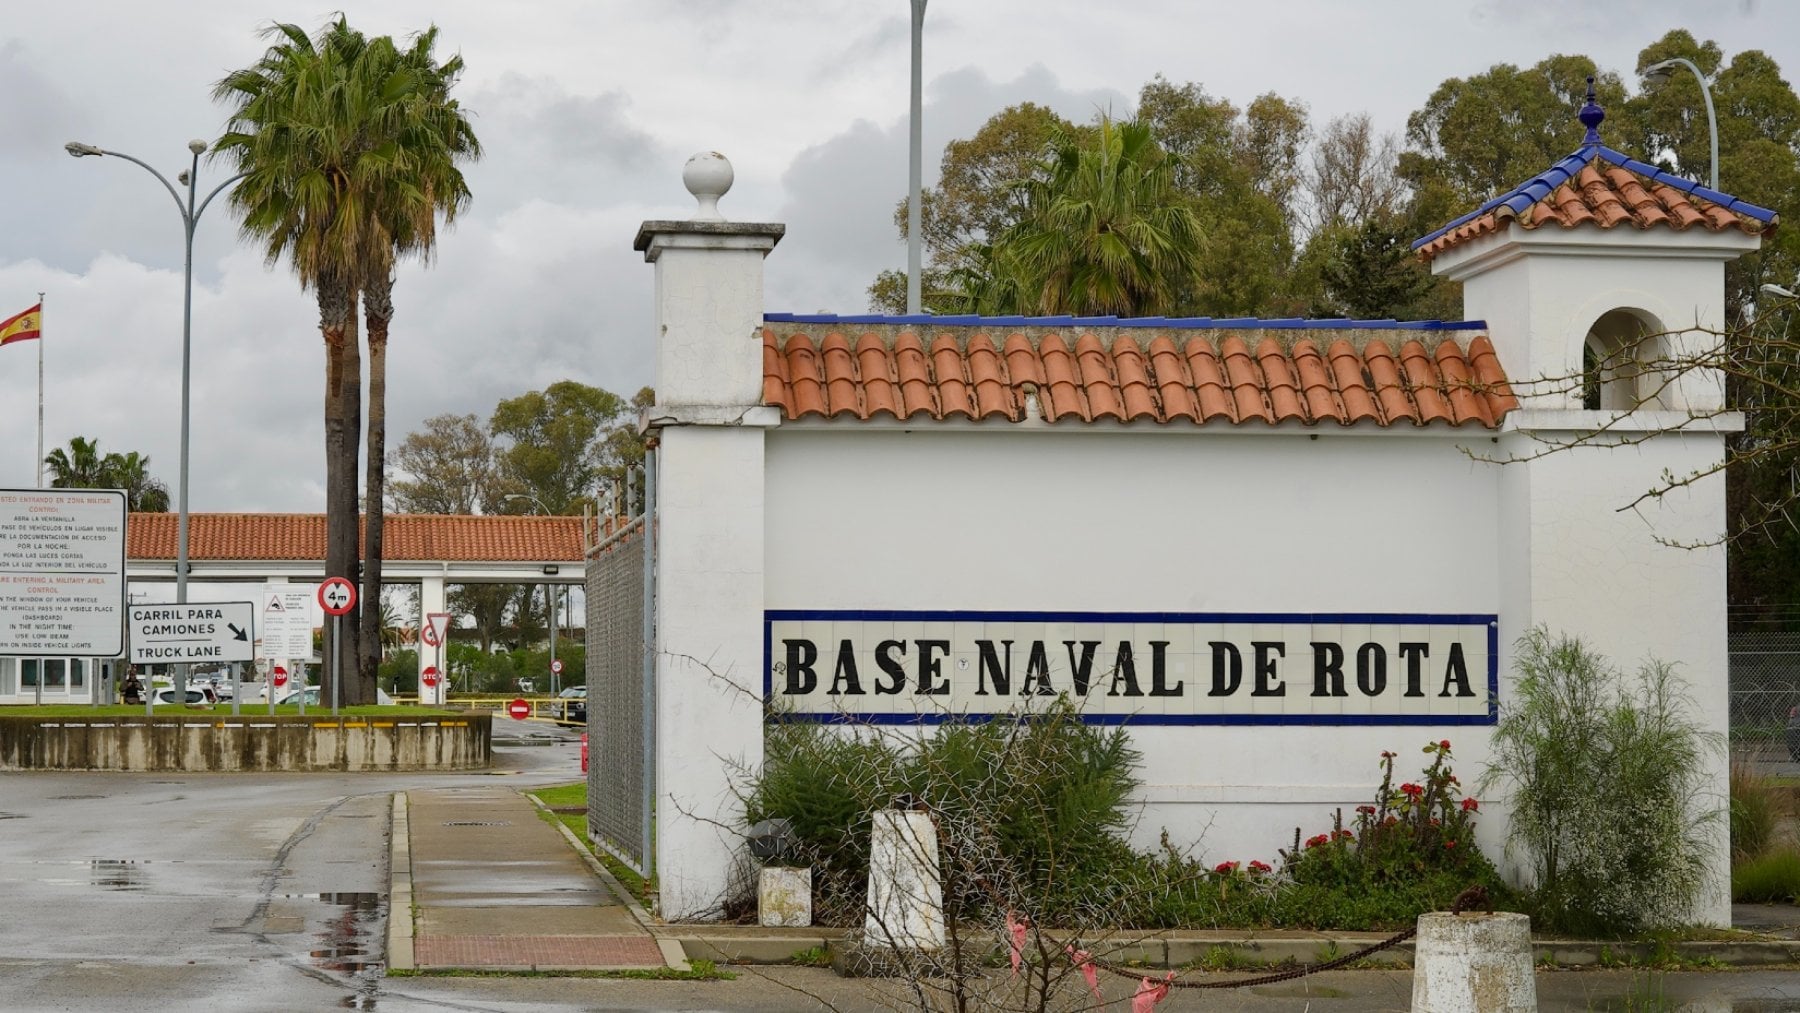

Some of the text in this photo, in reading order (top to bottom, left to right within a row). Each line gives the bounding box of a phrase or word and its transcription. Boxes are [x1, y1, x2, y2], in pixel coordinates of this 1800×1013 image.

[328, 591, 336, 601] 4
[133, 609, 223, 621] CARRIL PARA
[142, 623, 215, 635] CAMIONES
[137, 646, 222, 658] TRUCK LANE
[782, 639, 1476, 697] BASE NAVAL DE ROTA
